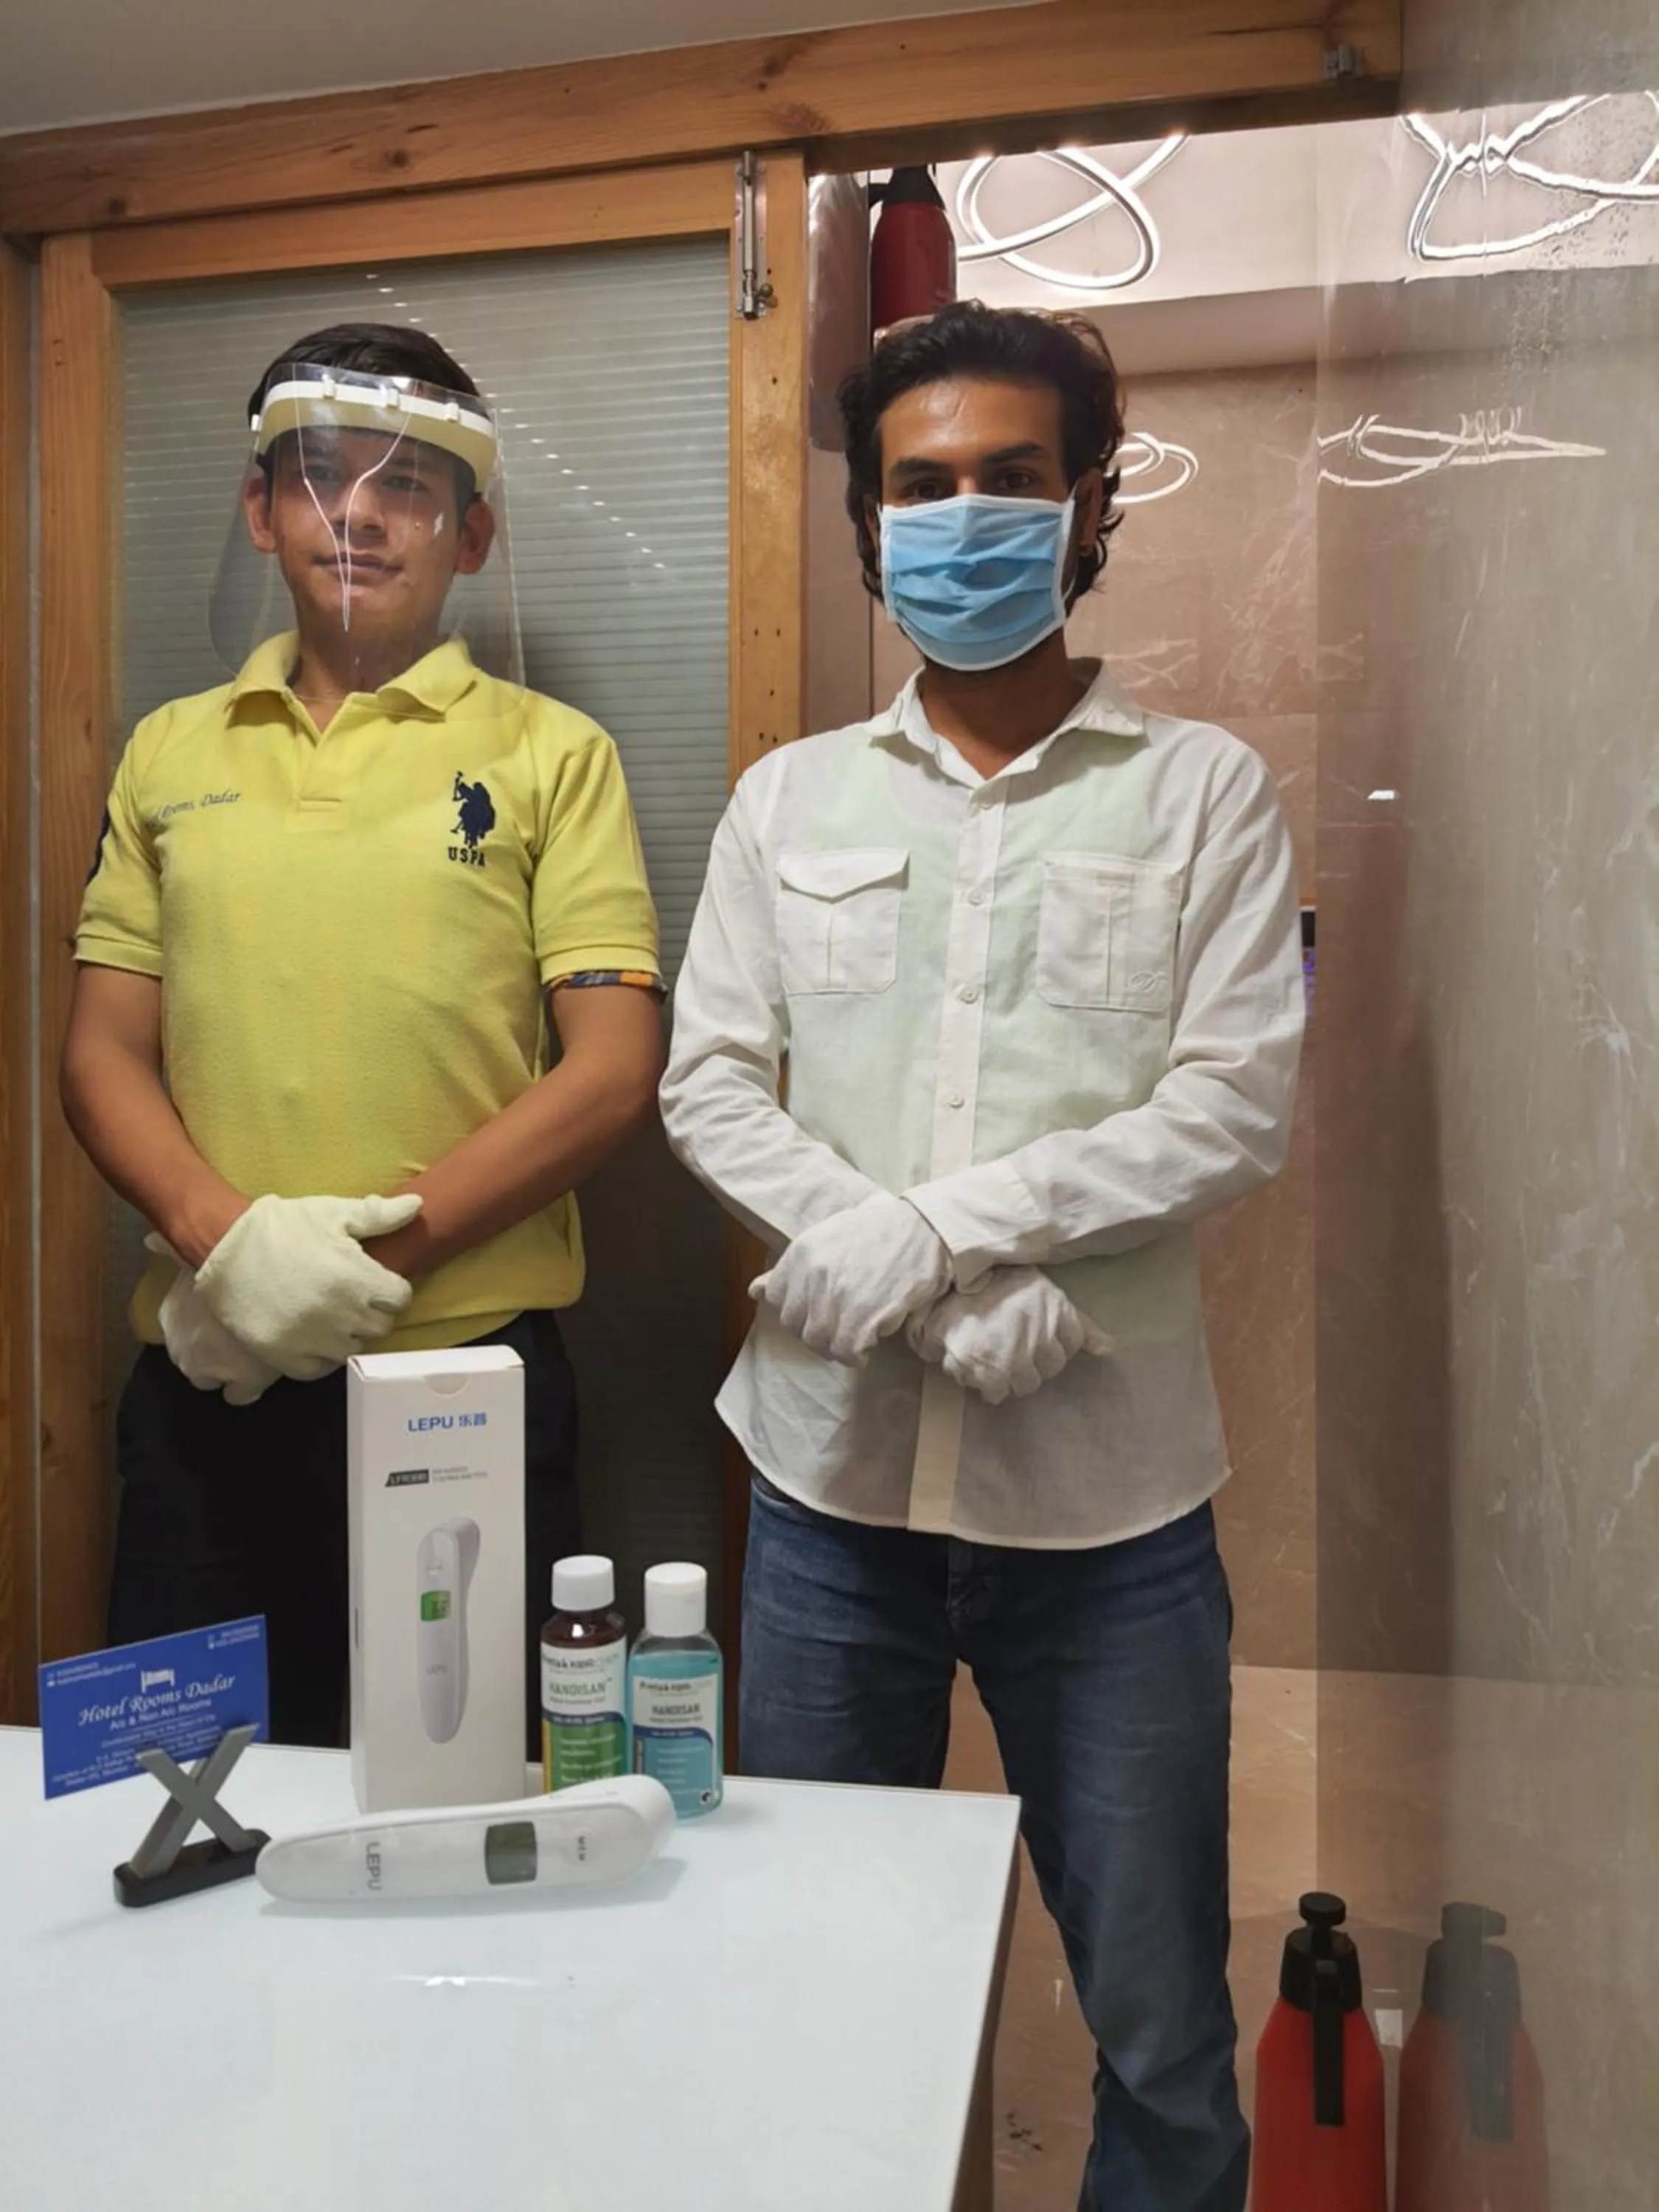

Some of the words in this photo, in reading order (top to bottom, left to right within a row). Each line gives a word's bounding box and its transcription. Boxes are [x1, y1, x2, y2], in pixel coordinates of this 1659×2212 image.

[448, 846, 485, 867] USPA
[408, 1415, 454, 1433] LEPU
[77, 1697, 127, 1727] Hotel
[129, 1688, 182, 1714] Rooms
[184, 1674, 237, 1700] Dadar
[365, 1840, 383, 1891] LEPU
